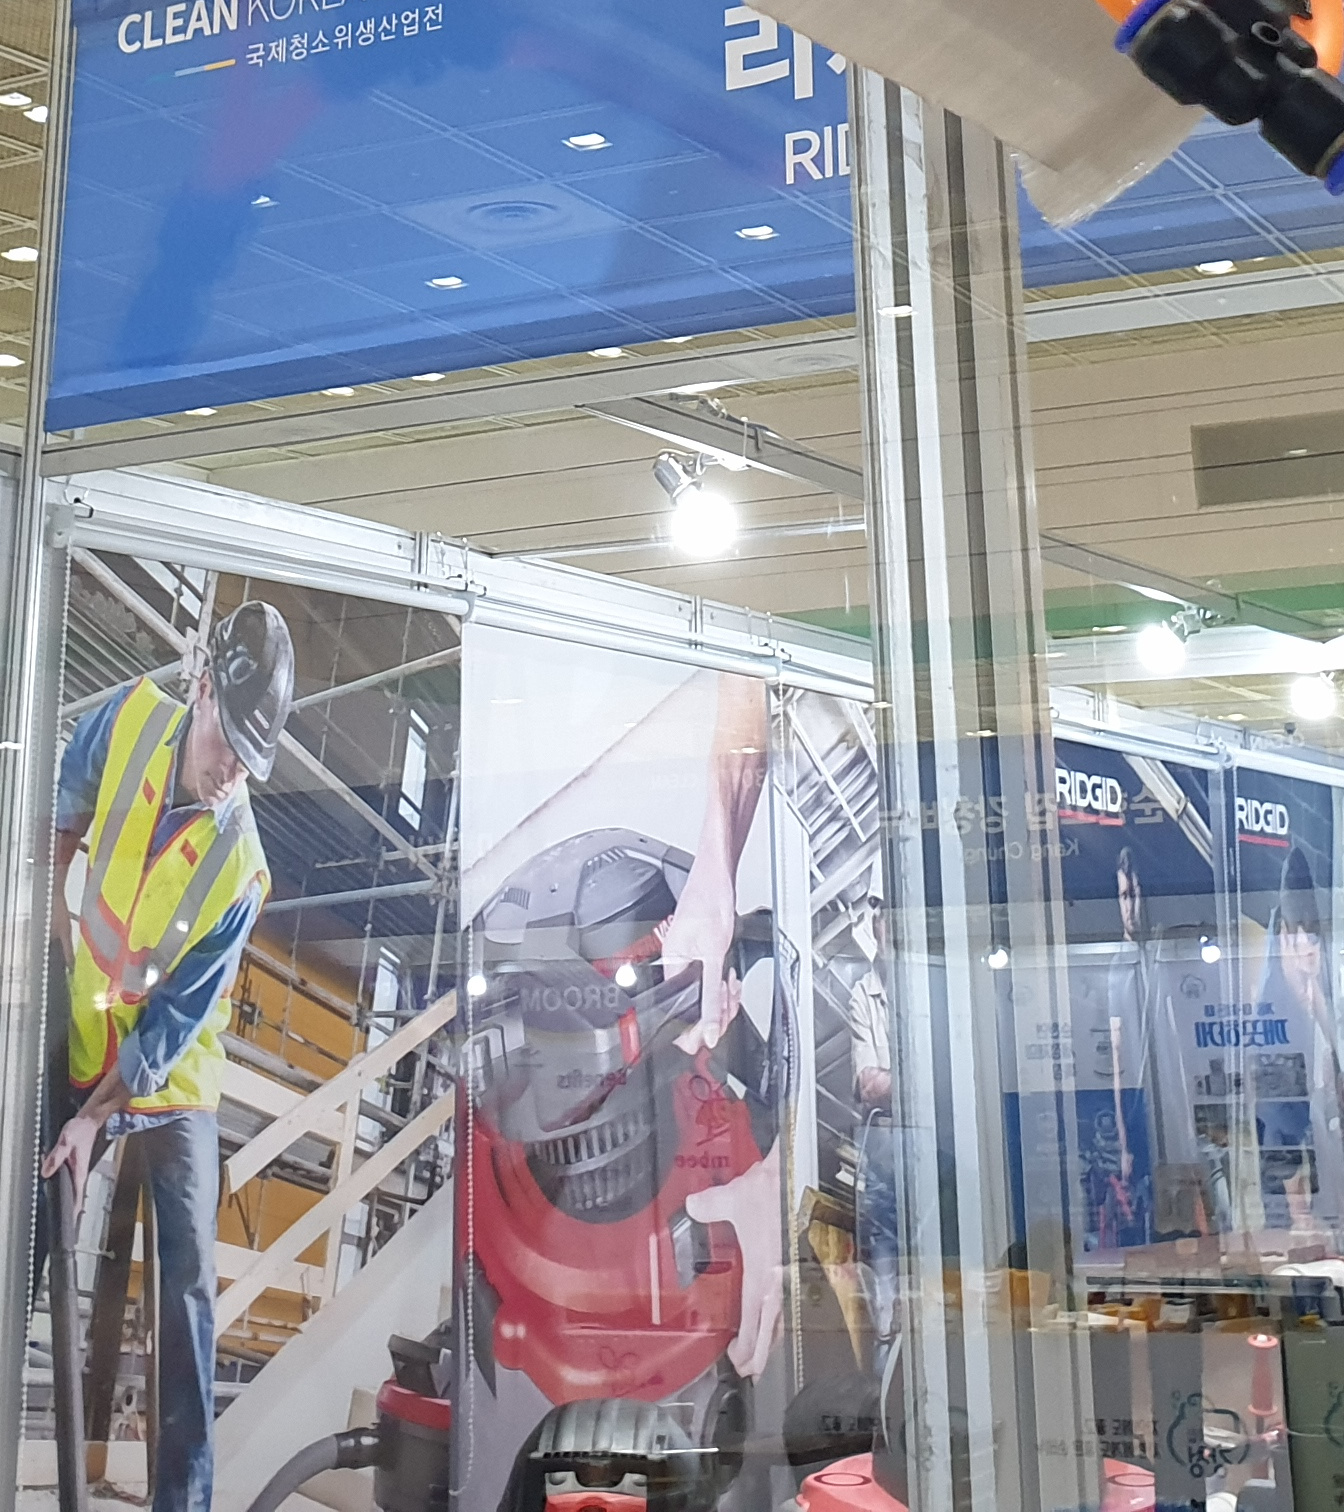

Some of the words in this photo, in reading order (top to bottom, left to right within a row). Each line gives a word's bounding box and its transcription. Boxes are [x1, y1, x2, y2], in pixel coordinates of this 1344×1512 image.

[245, 3, 444, 68] 국제청소위생산업전
[725, 5, 846, 100] 리
[1055, 767, 1122, 813] RIDGID
[1236, 797, 1289, 835] RIDGID
